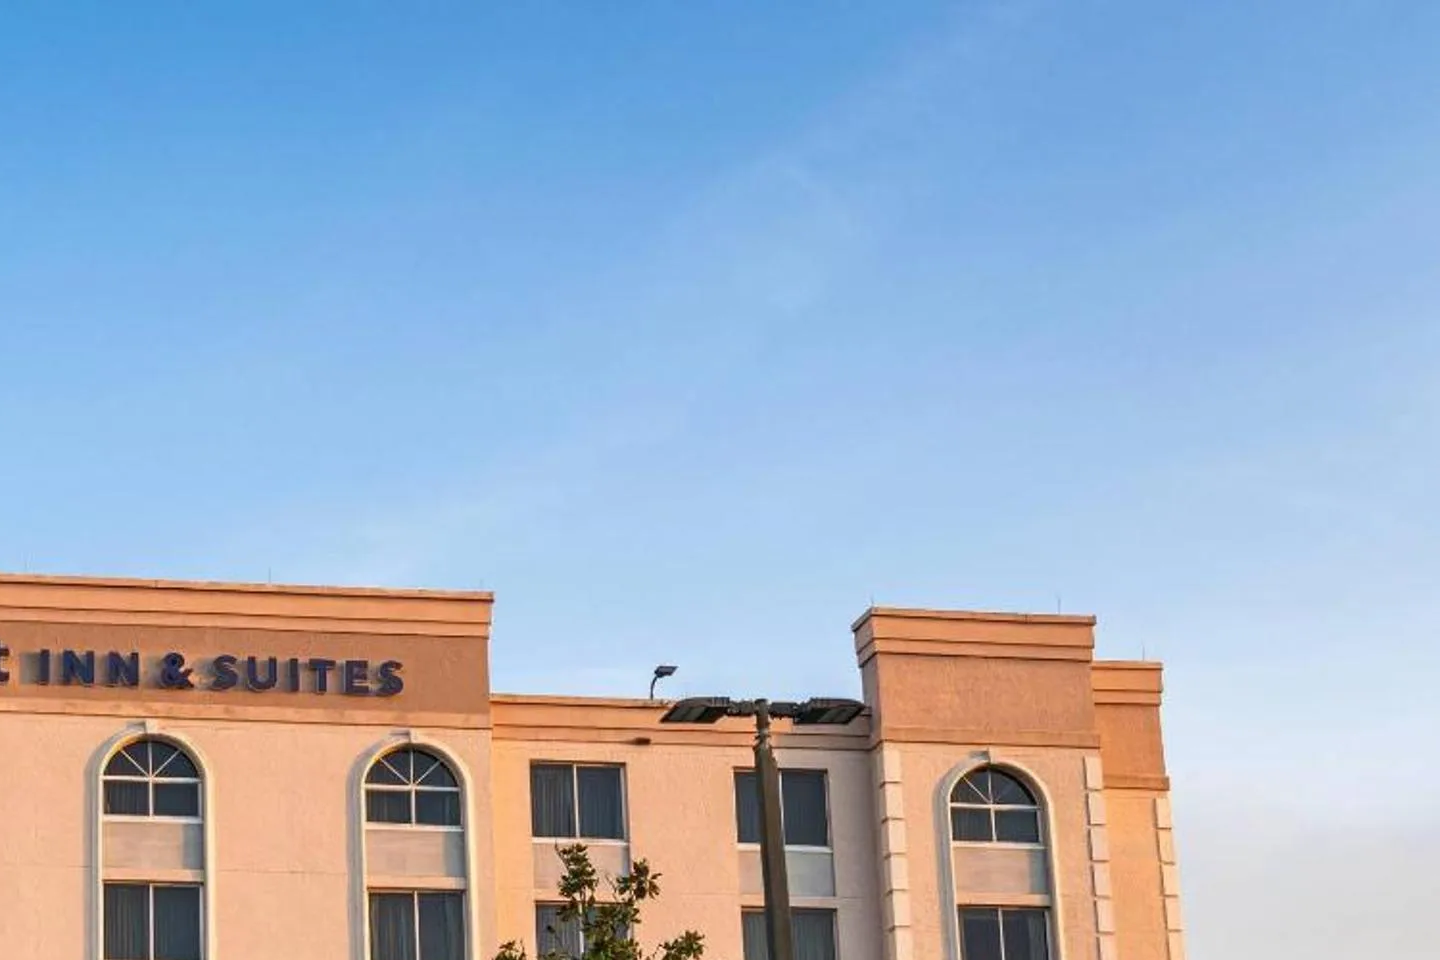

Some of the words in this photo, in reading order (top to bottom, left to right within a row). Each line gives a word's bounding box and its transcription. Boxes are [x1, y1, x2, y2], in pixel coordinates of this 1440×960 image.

[36, 648, 140, 688] INN
[160, 651, 195, 690] &
[211, 653, 404, 697] SUITES
